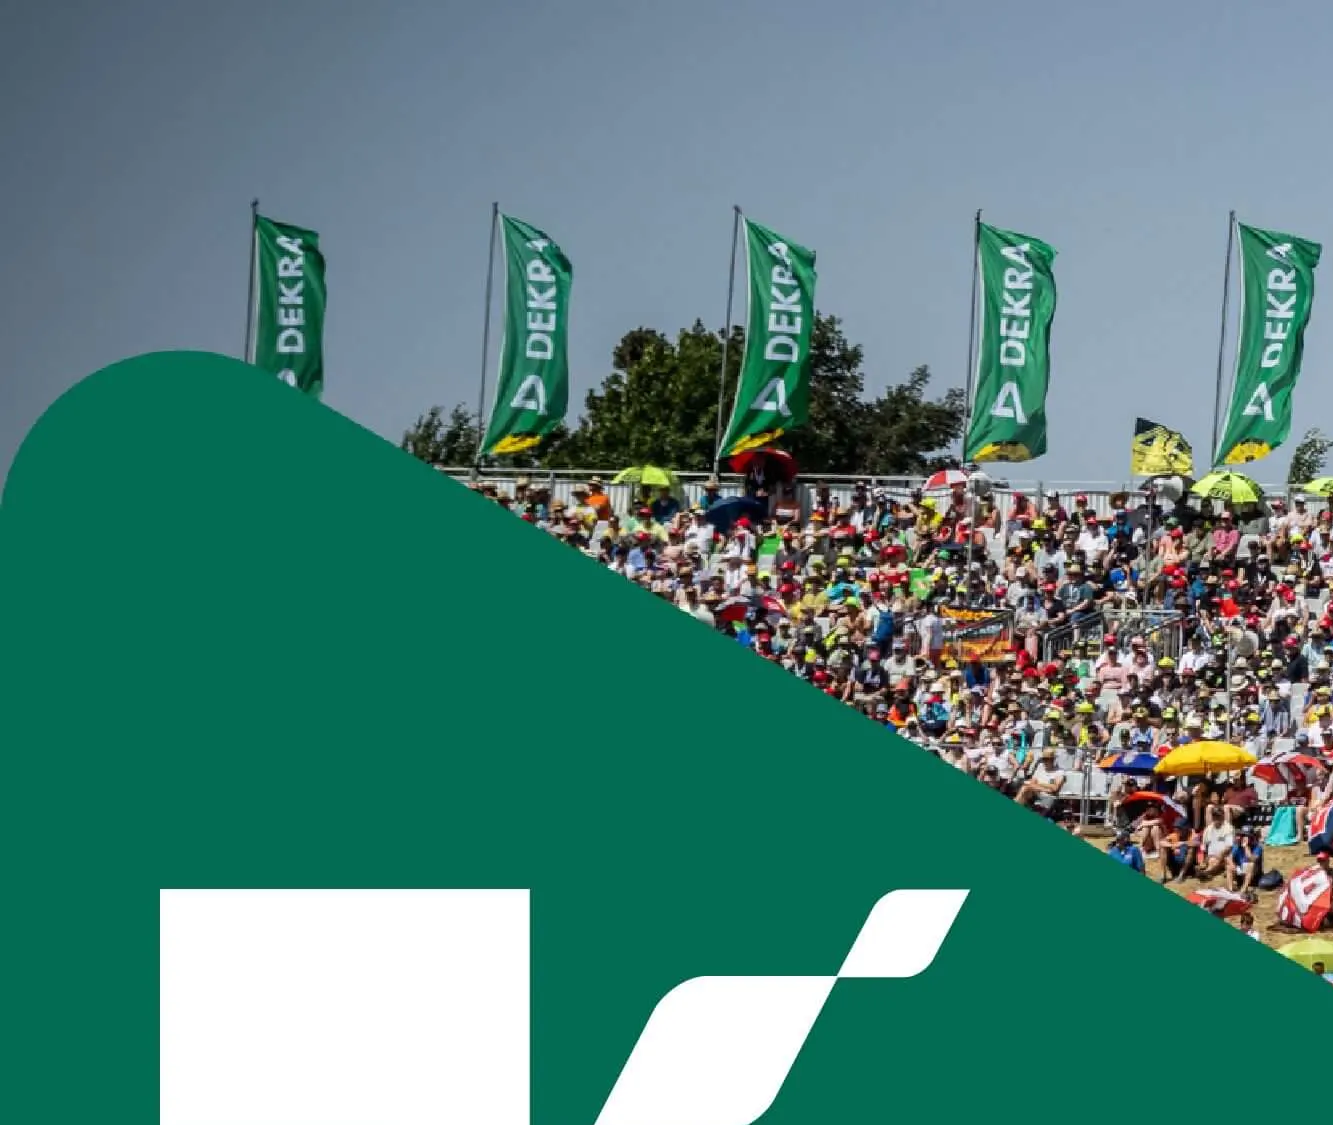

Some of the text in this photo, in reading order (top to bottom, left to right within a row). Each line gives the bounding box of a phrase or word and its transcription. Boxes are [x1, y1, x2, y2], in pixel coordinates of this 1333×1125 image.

[276, 235, 304, 354] DEKRA
[766, 243, 803, 362] DEKRA
[1000, 243, 1034, 366] DEKRA
[1261, 243, 1297, 369] DEKRA
